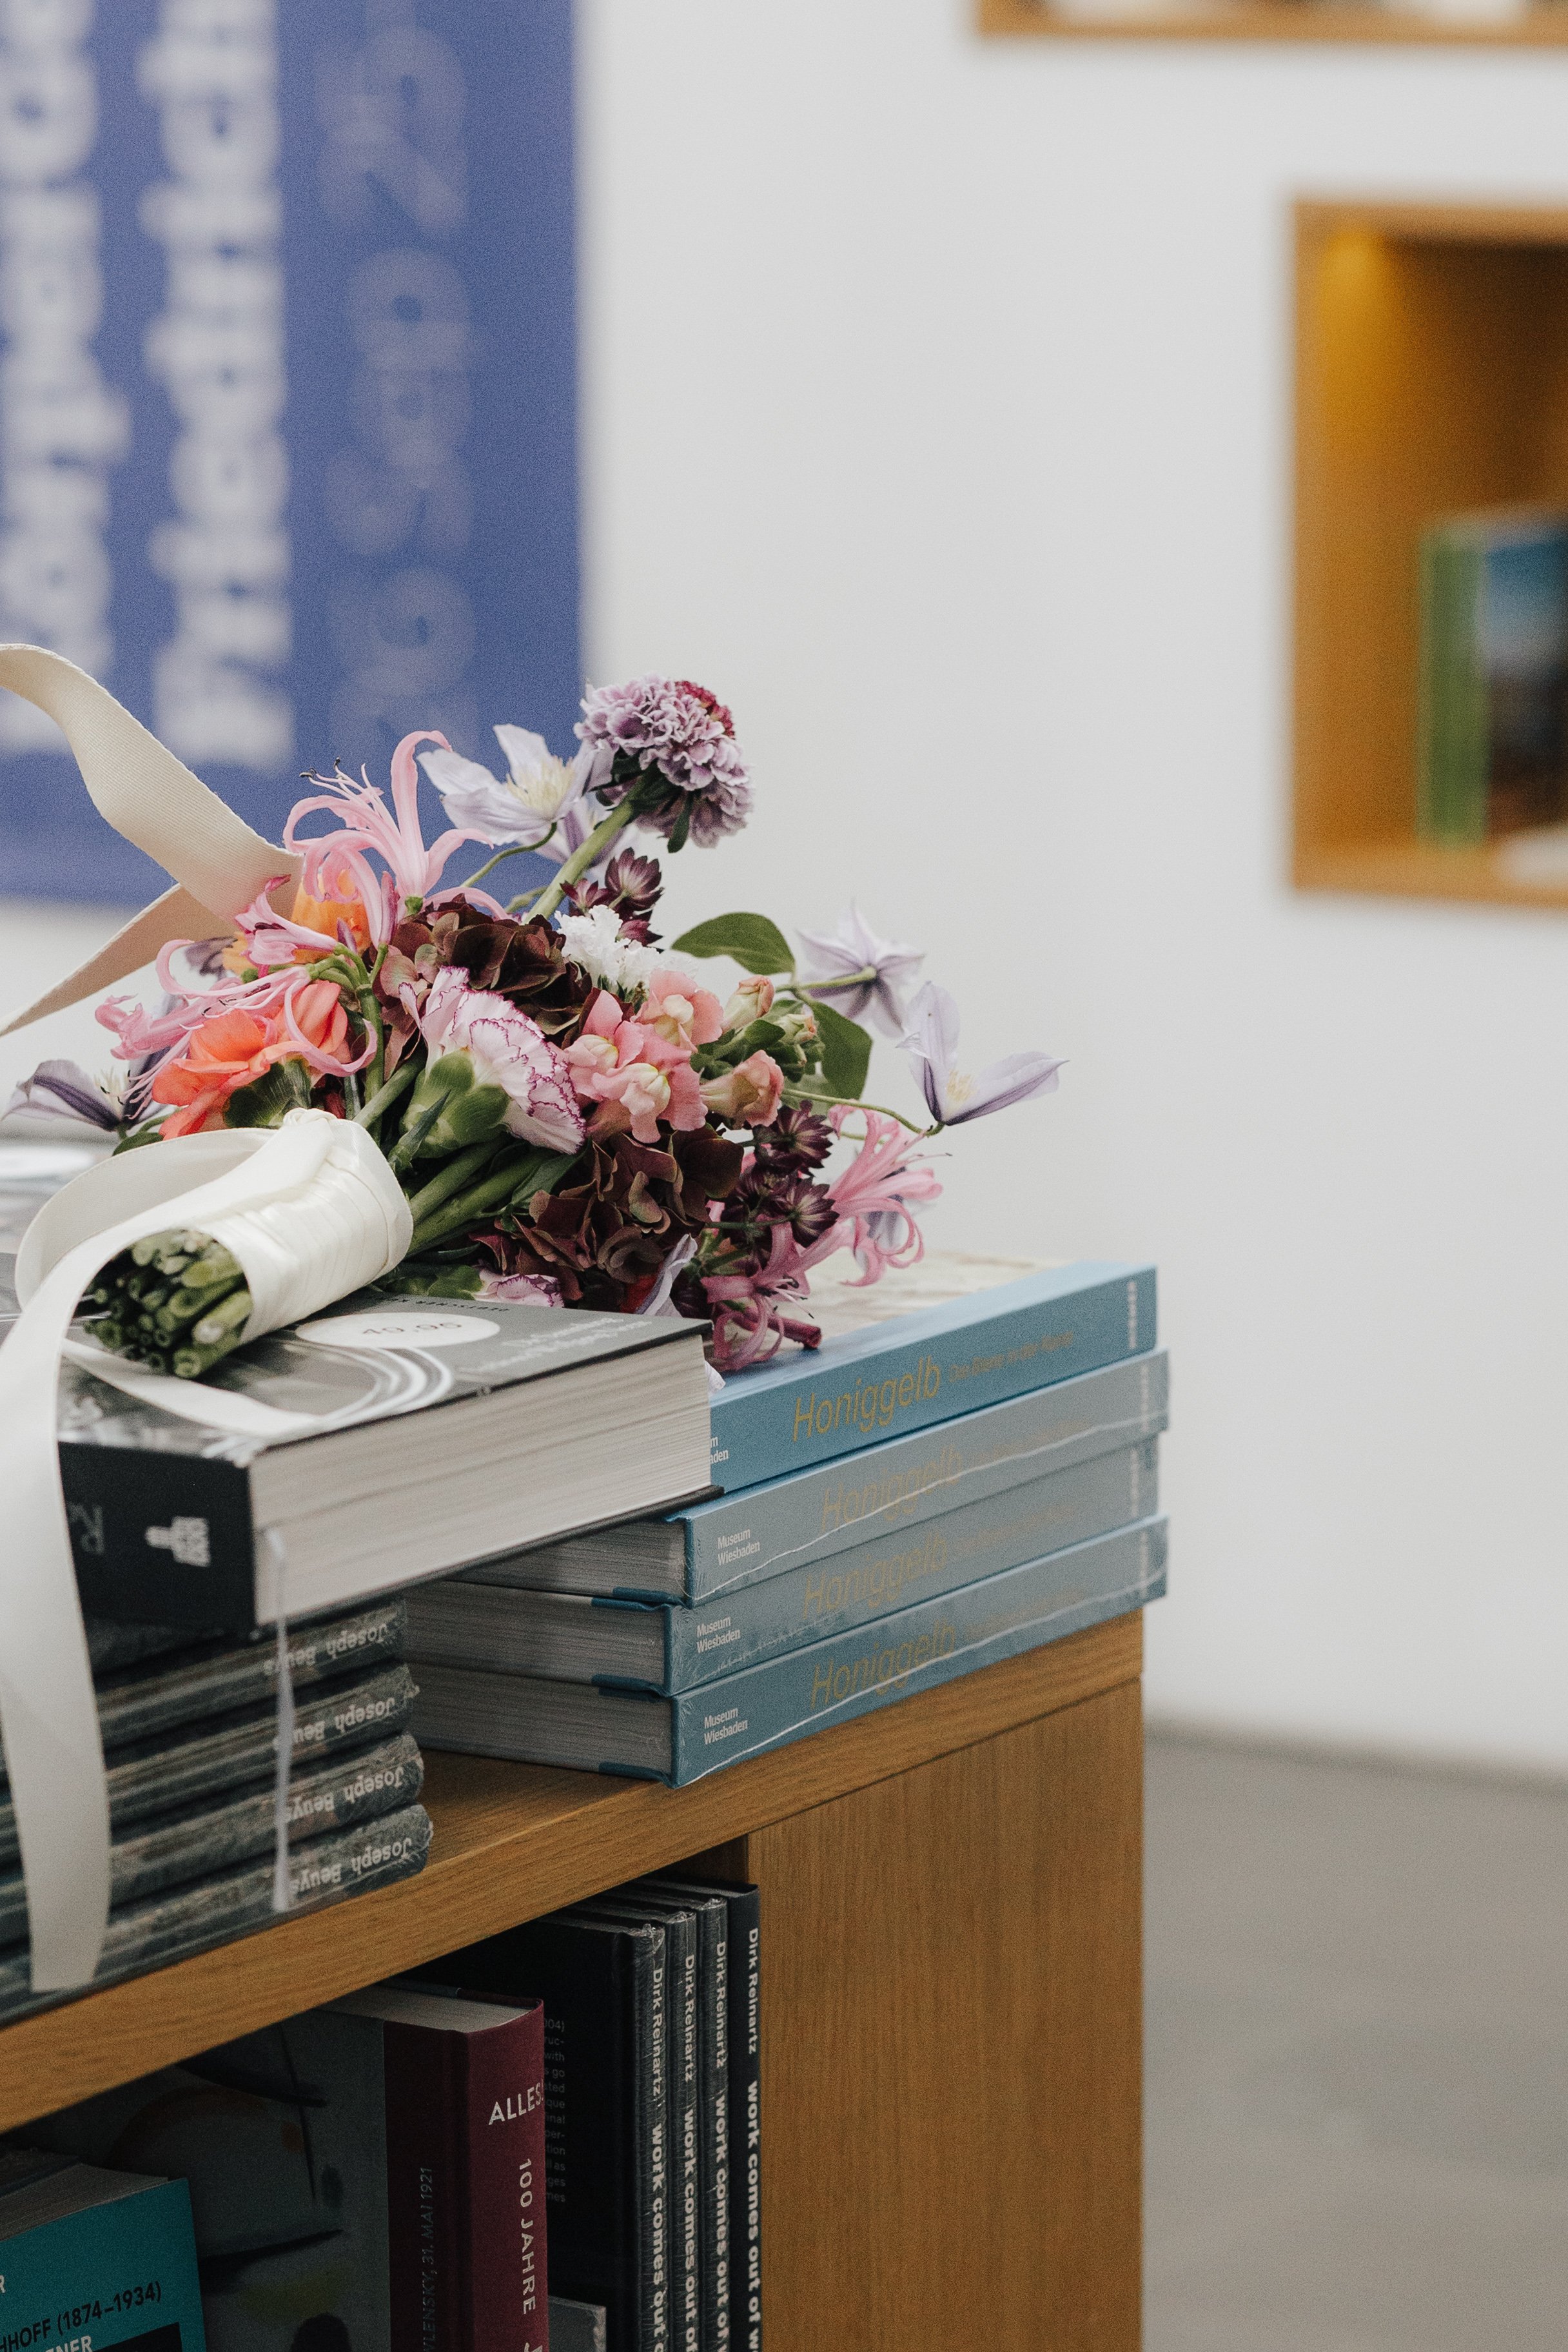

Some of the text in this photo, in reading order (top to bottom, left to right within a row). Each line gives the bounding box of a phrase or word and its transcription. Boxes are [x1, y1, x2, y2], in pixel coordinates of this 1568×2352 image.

[792, 1357, 941, 1441] Honiggelb
[821, 1446, 962, 1531] Honiggelb
[718, 1528, 750, 1549] Museum
[718, 1542, 760, 1566] Wiesbaden
[326, 1623, 387, 1660] Joseph
[697, 1616, 731, 1638] Museum
[697, 1629, 741, 1653] Wiesbaden
[810, 1618, 957, 1710] Honiggelb
[335, 1698, 395, 1734] Joseph
[704, 1707, 738, 1729] Museum
[704, 1719, 748, 1745] Wiesbaden
[344, 1767, 404, 1803] Joseph
[351, 1838, 412, 1875] Joseph
[716, 1941, 726, 1983] Dirk
[749, 1928, 759, 1969] Dirk
[652, 1968, 663, 2010] Dirk
[716, 1986, 727, 2068] Reinartz
[749, 1972, 759, 2055] Reinartz
[652, 2013, 663, 2097] Reinartz
[716, 2095, 728, 2163] work
[748, 2080, 760, 2149] work
[652, 2123, 665, 2192] work
[684, 1954, 698, 2352] Dirk Reinartz work comes out of
[420, 2167, 433, 2199] 1921
[748, 2153, 759, 2240] comes
[420, 2204, 434, 2240] MAI
[716, 2168, 727, 2256] comes
[422, 2244, 434, 2265] 31.
[520, 2159, 536, 2315] 100 JAHRE
[652, 2197, 663, 2285] comes
[716, 2261, 729, 2307] out
[748, 2245, 761, 2292] out
[653, 2293, 667, 2337] out
[717, 2311, 730, 2339] of
[748, 2297, 761, 2322] of
